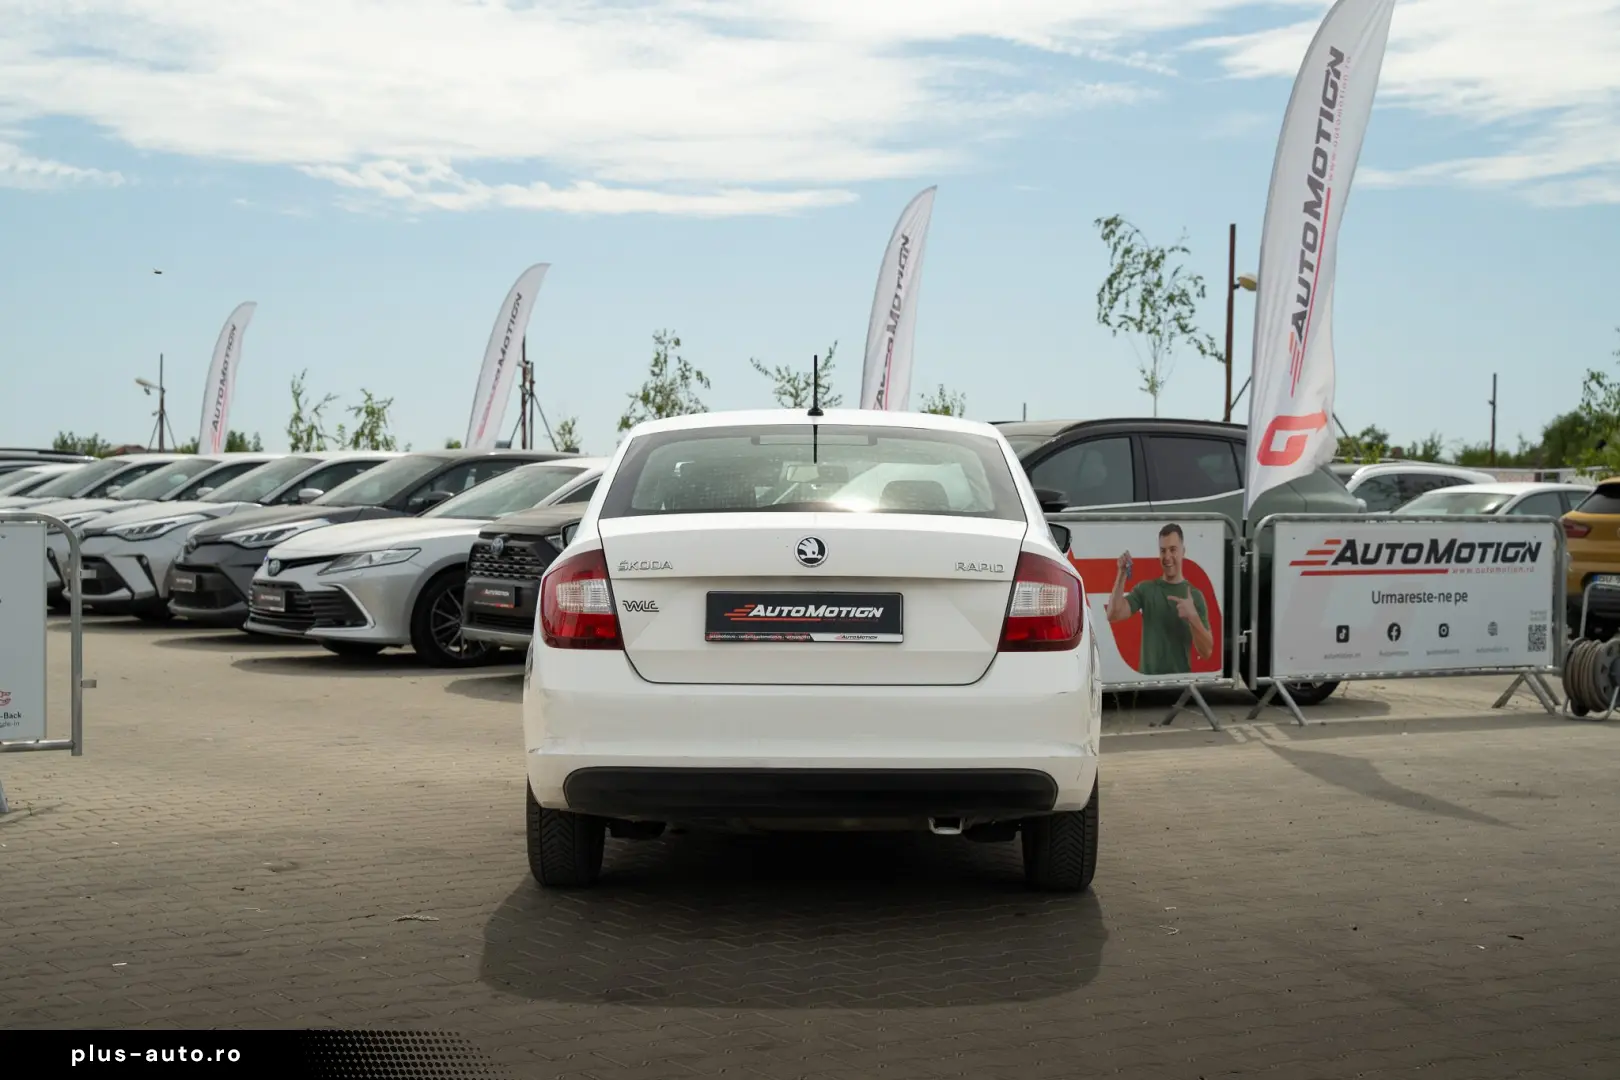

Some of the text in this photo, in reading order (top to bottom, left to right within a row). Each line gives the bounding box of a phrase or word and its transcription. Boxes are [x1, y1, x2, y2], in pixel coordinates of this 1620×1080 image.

[954, 562, 1005, 573] RAPID
[1371, 591, 1469, 605] Urmareste-ne pe
